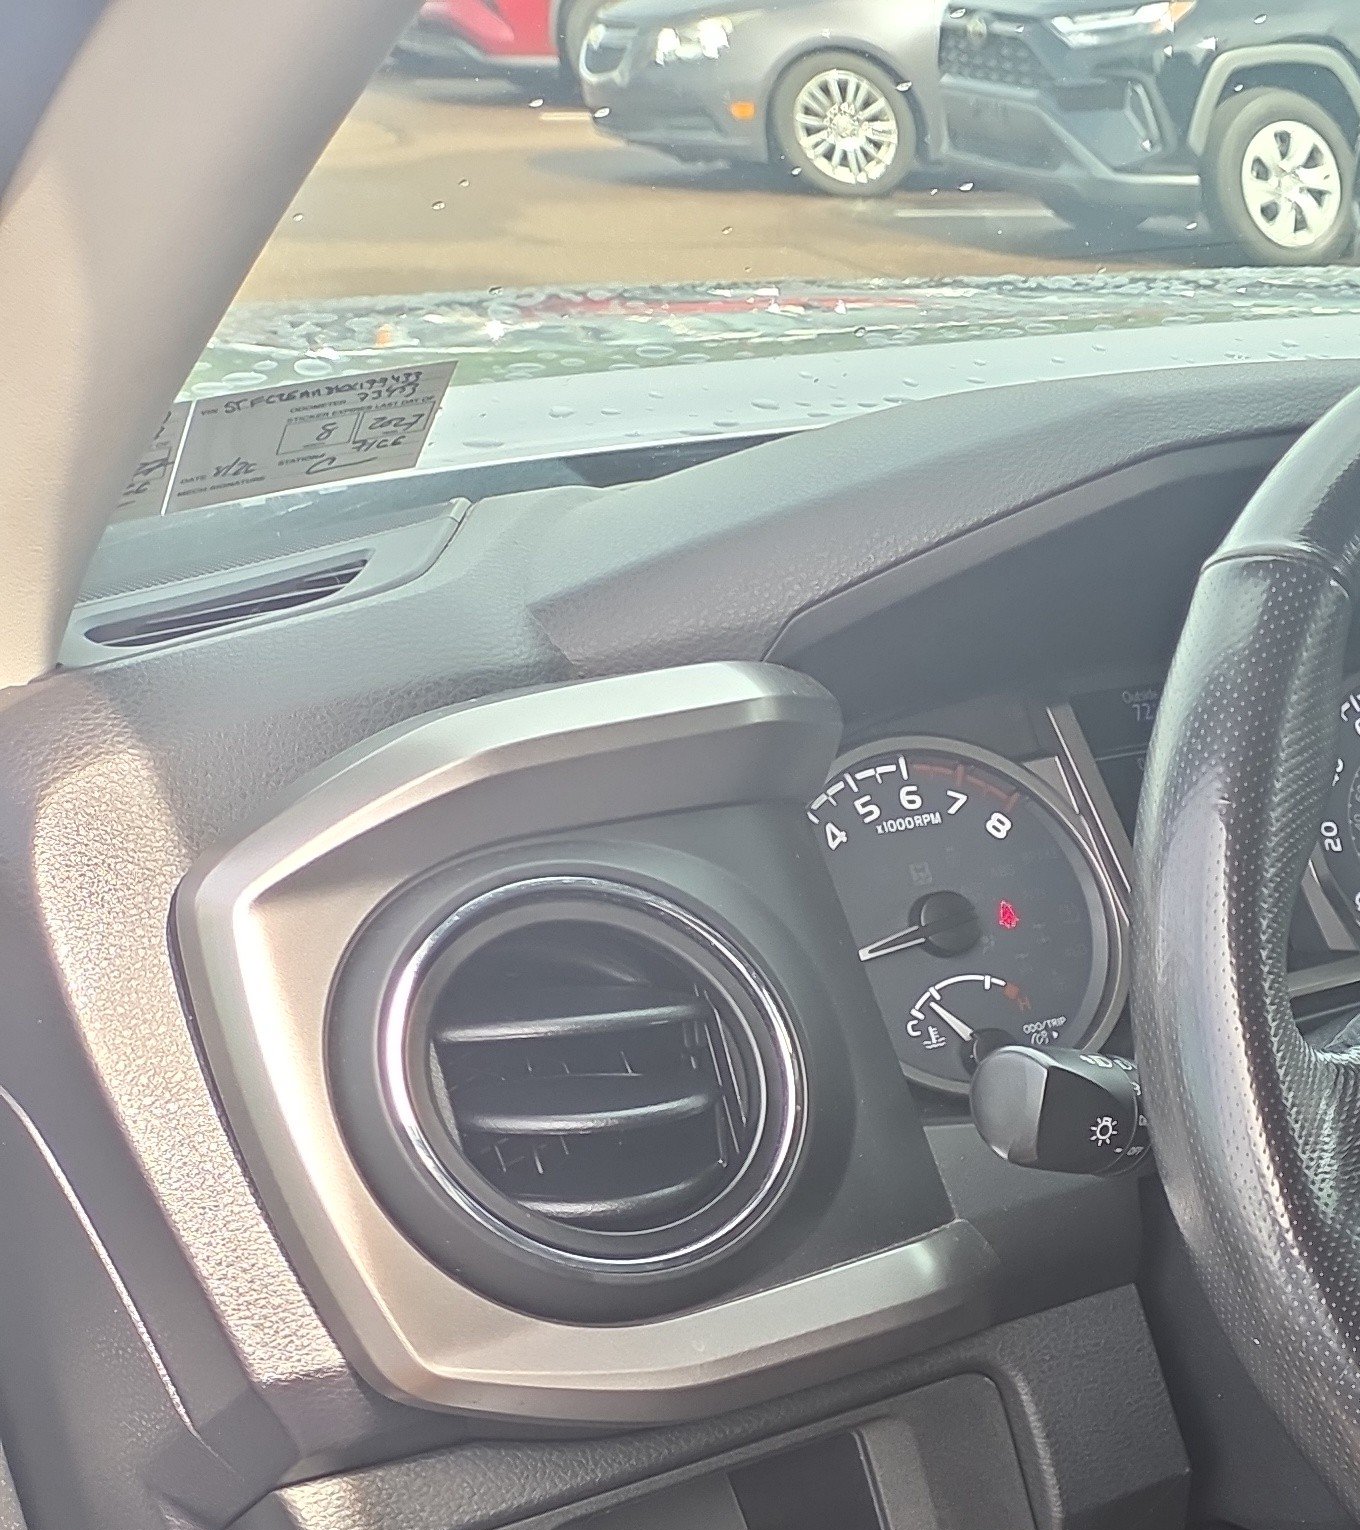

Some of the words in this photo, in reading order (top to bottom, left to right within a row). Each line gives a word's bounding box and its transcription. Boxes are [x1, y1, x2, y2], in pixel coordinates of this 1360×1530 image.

[854, 794, 881, 824] 5
[899, 785, 923, 811] 6
[946, 790, 968, 815] 7
[825, 822, 847, 851] 4
[985, 812, 1012, 840] 8
[1320, 820, 1343, 852] 20
[906, 1020, 922, 1038] C
[1022, 1015, 1067, 1035] ODO/TRIP
